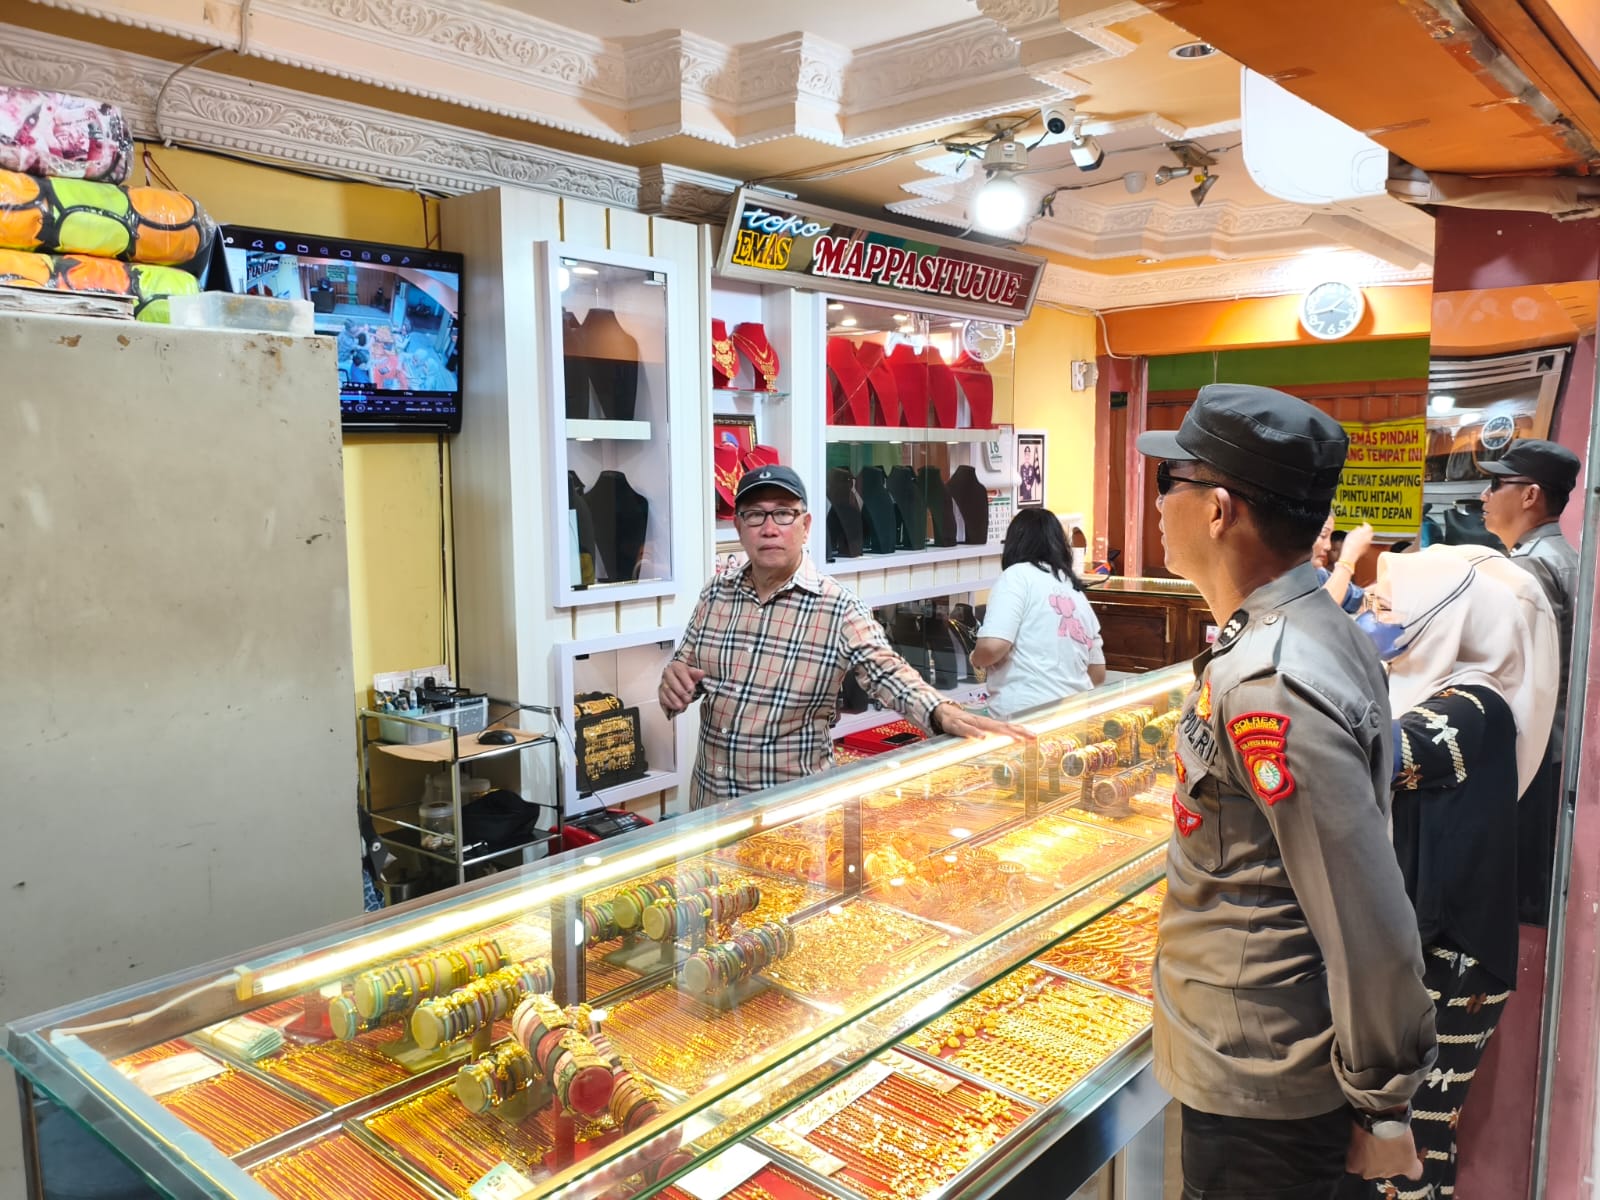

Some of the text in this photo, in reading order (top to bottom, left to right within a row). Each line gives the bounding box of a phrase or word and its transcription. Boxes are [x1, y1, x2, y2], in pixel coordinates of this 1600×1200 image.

[743, 209, 830, 237] toko
[733, 230, 793, 269] EMAS
[812, 236, 1022, 307] MAPPASITUJUE
[1350, 429, 1419, 446] EMAS PINDAH
[1367, 448, 1405, 462] TEMPAT
[1408, 448, 1422, 462] INI
[1346, 474, 1377, 487] LEWAT
[1378, 474, 1421, 487] SAMPING
[1340, 490, 1368, 503] (PINTU
[1370, 490, 1402, 505] HITAM)
[1333, 505, 1412, 520] GA LEWAT DEPAN
[1233, 716, 1278, 731] POLRES
[1181, 708, 1216, 762] POLRI
